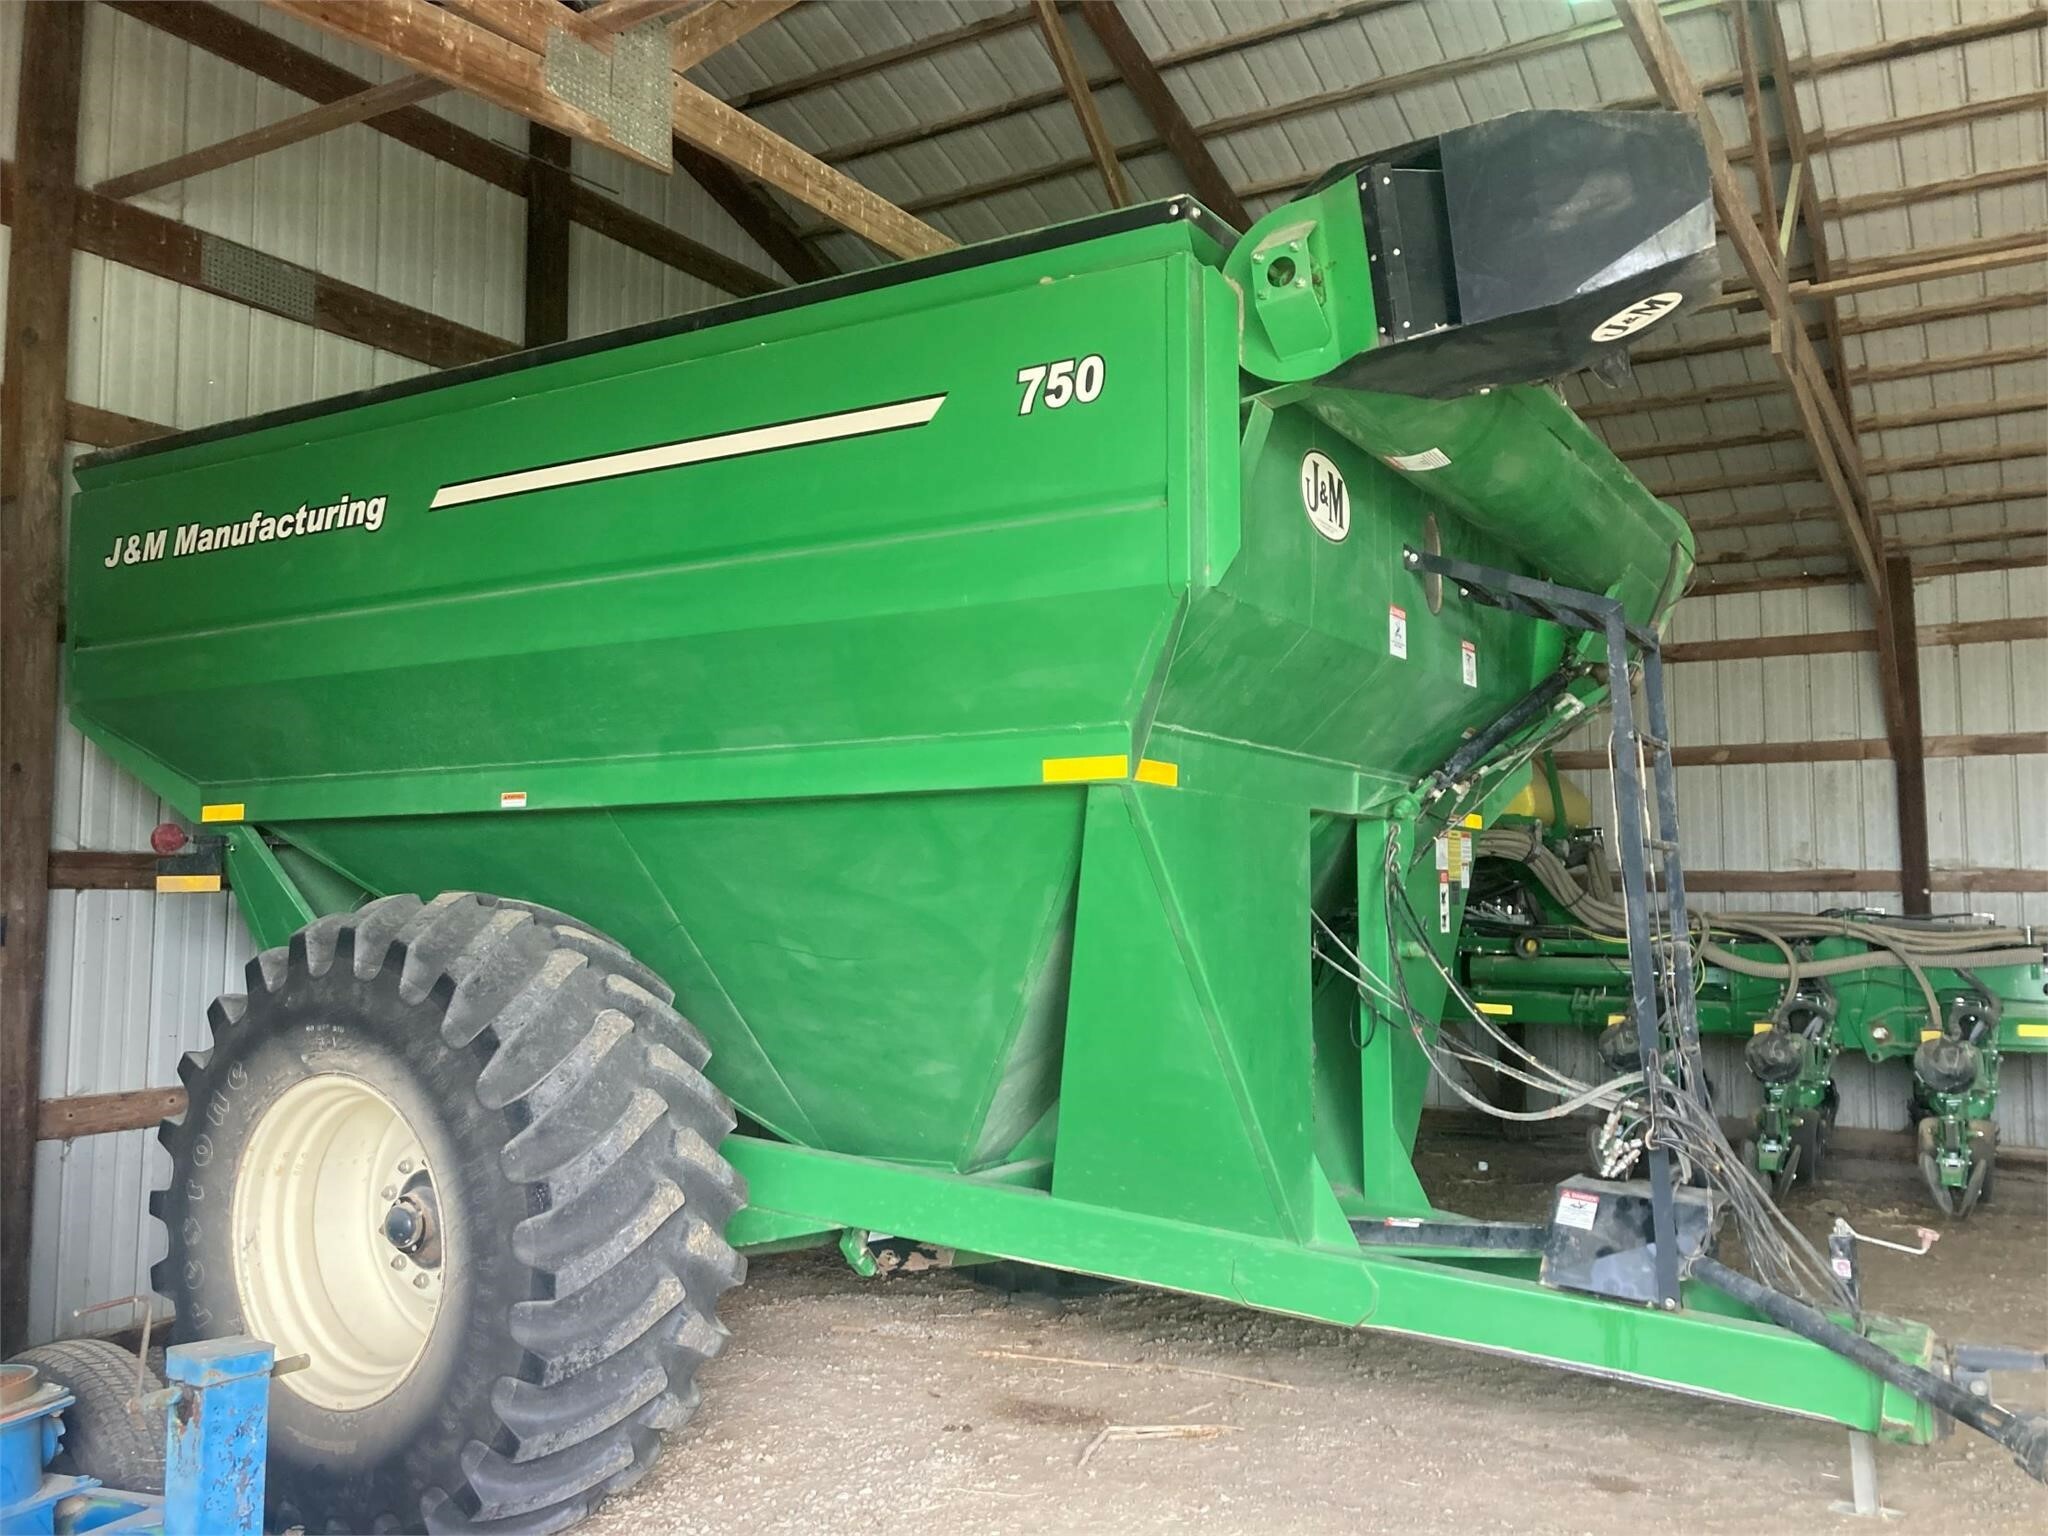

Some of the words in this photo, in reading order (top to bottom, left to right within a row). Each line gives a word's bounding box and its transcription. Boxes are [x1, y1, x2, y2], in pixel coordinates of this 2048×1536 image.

[1601, 298, 1673, 338] J&M
[1016, 353, 1106, 416] 750
[1305, 459, 1345, 530] J&M
[103, 528, 168, 568] J&M
[172, 493, 389, 558] Manufacturing
